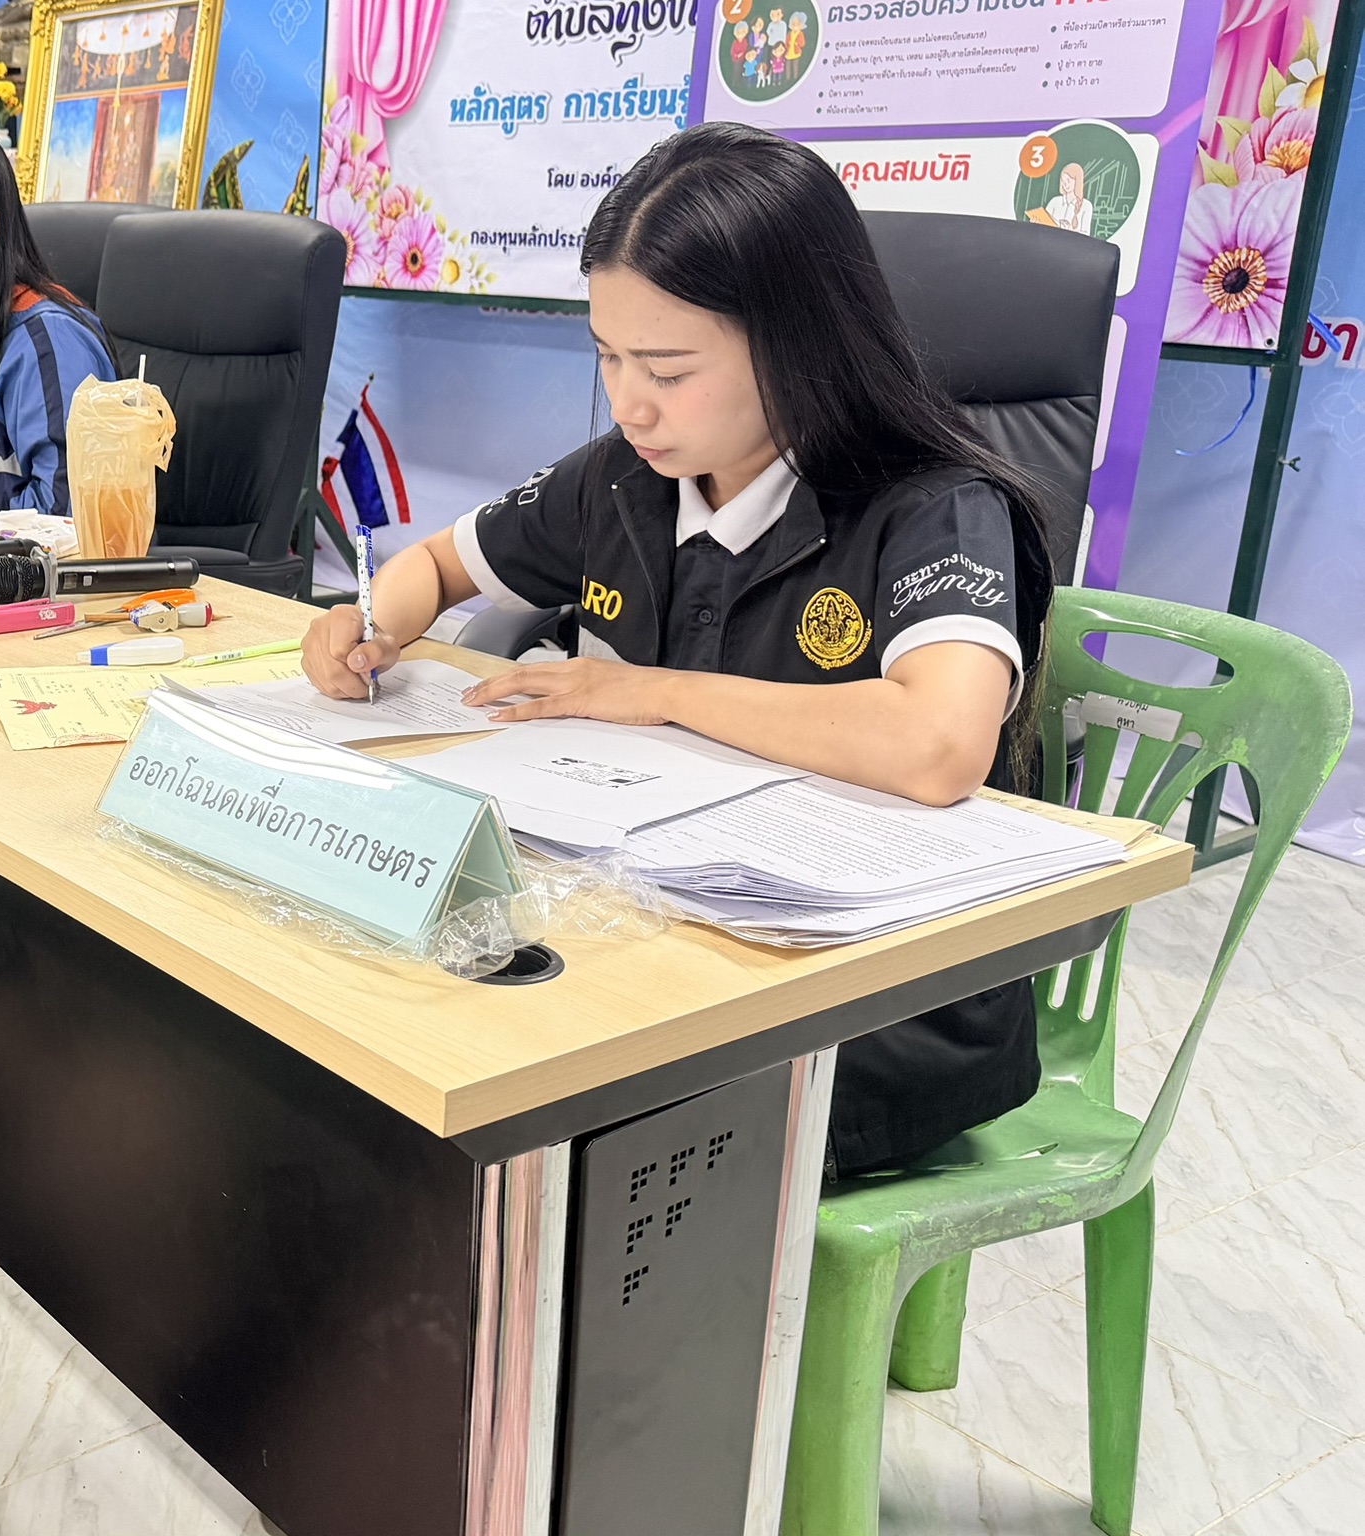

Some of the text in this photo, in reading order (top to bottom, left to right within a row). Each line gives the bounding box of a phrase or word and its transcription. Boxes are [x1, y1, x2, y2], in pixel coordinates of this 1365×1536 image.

[450, 86, 547, 135] หลักสูตร
[836, 153, 971, 190] คุณสมบัติ
[1030, 146, 1046, 168] 3
[547, 168, 575, 188] โดย
[892, 553, 1004, 593] กระทรวงเกษตร
[889, 573, 1009, 618] Family
[128, 754, 438, 889] ออกโฉนดเพื่อการเกษตร
